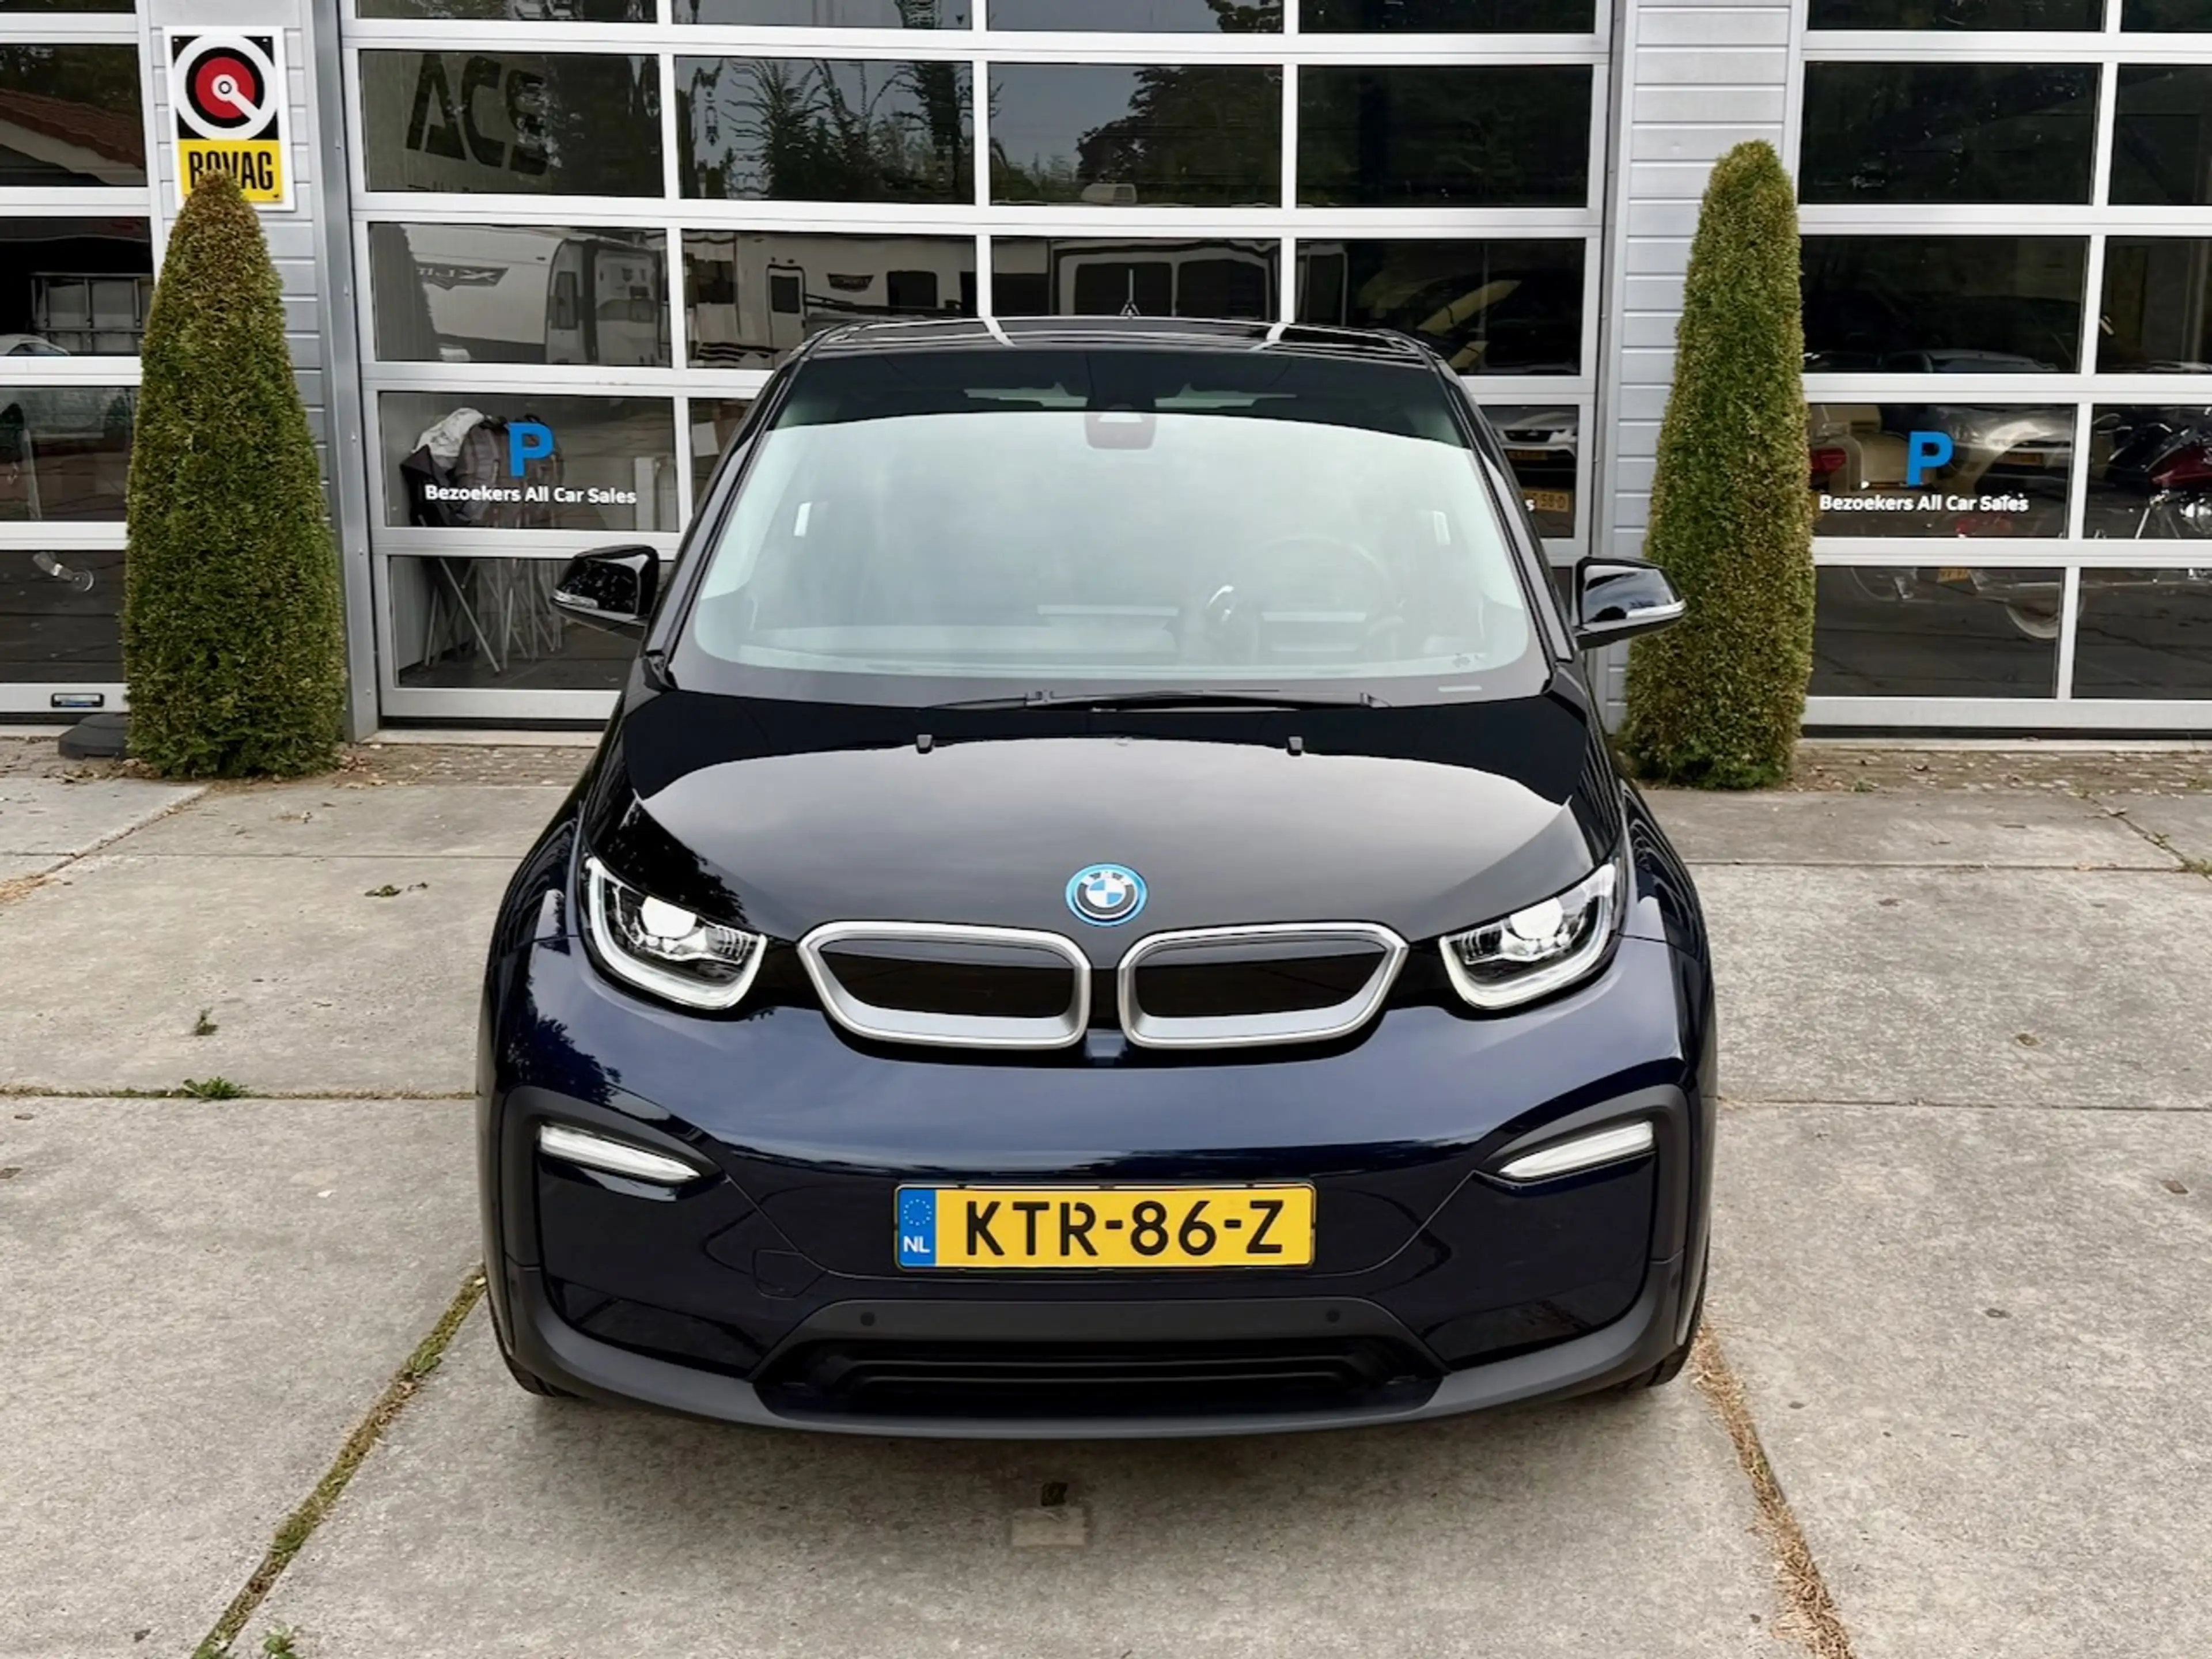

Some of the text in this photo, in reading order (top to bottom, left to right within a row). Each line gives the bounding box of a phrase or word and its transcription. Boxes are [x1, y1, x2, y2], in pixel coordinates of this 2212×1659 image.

[509, 422, 554, 478] P
[1907, 430, 1955, 487] P
[425, 484, 637, 505] Bezoekers All Car Sales
[1819, 494, 1914, 512] Bezoekers
[1916, 494, 1942, 511] All
[1945, 495, 1978, 512] Car
[903, 1199, 1284, 1257] NL KTR-86-Z
